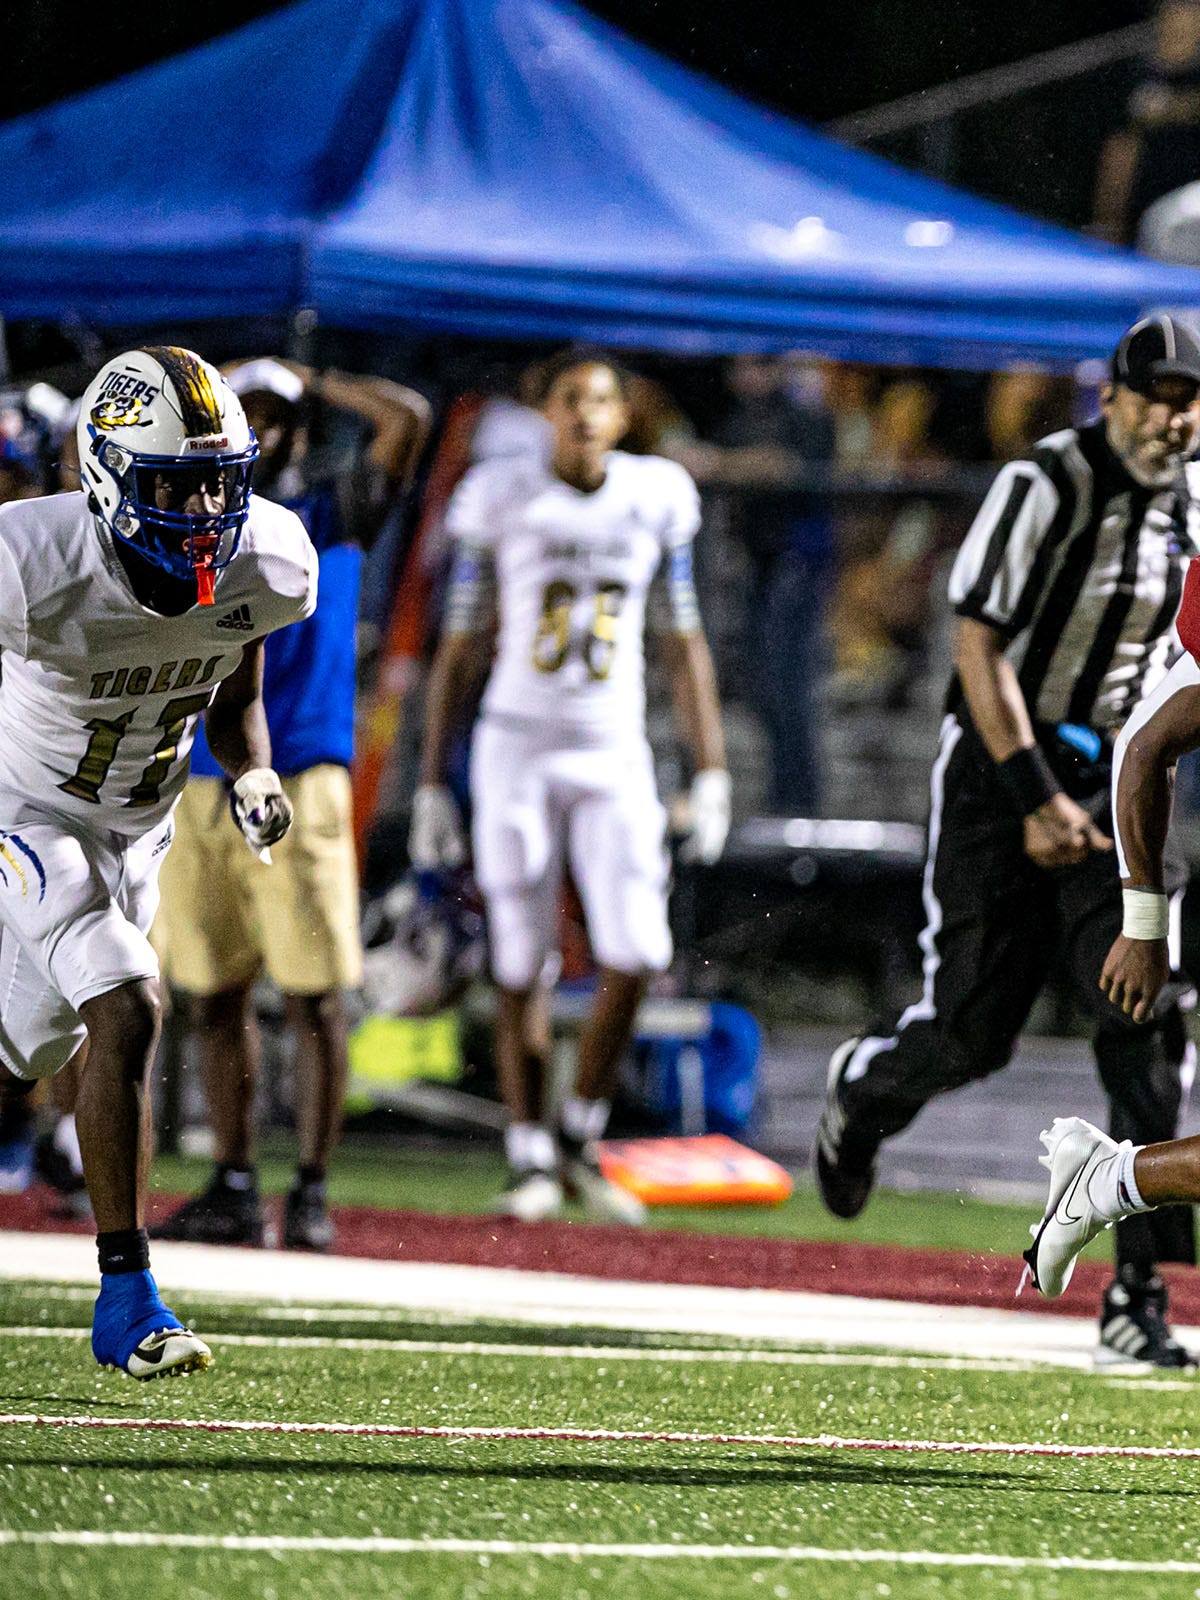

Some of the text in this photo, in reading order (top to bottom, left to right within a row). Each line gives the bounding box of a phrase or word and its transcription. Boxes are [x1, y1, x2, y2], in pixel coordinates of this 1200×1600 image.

[99, 371, 160, 407] TIGERS
[190, 437, 228, 450] Riddell
[216, 619, 255, 631] adidas
[89, 654, 225, 699] TIGERS
[56, 690, 214, 808] 17
